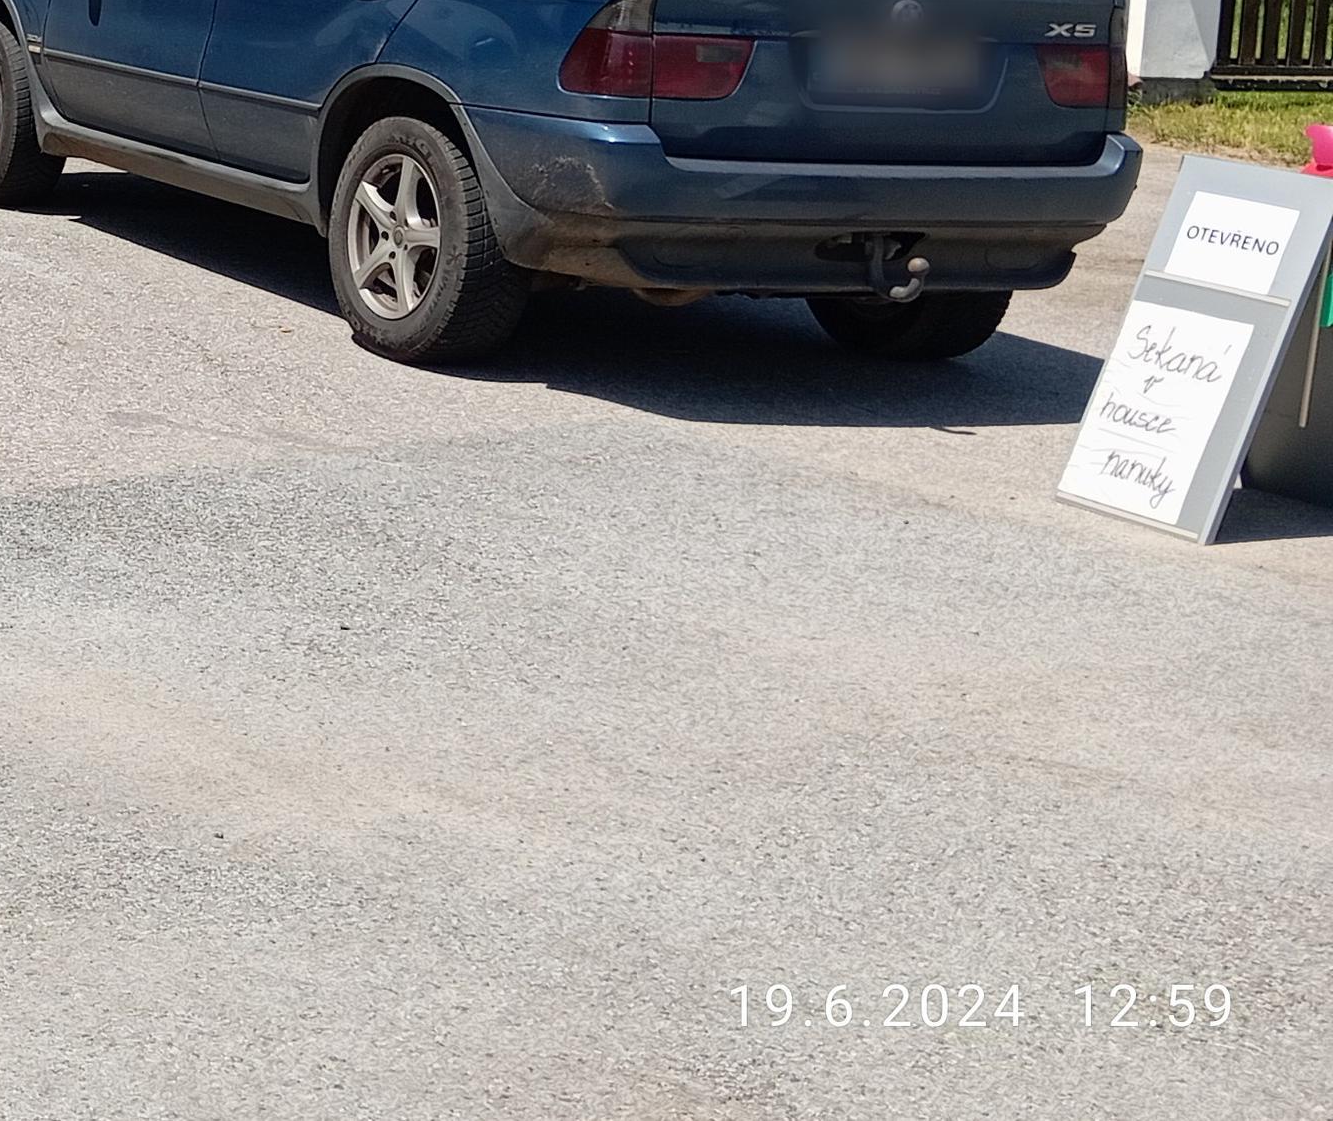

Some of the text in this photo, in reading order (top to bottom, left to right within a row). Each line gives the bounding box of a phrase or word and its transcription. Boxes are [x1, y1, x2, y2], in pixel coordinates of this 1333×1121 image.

[1044, 22, 1097, 38] X5
[1186, 225, 1280, 256] OTEVŘENO
[1127, 324, 1233, 383] Sekaná
[1143, 374, 1165, 394] v
[1099, 391, 1177, 434] housce
[1100, 449, 1177, 509] nanuky
